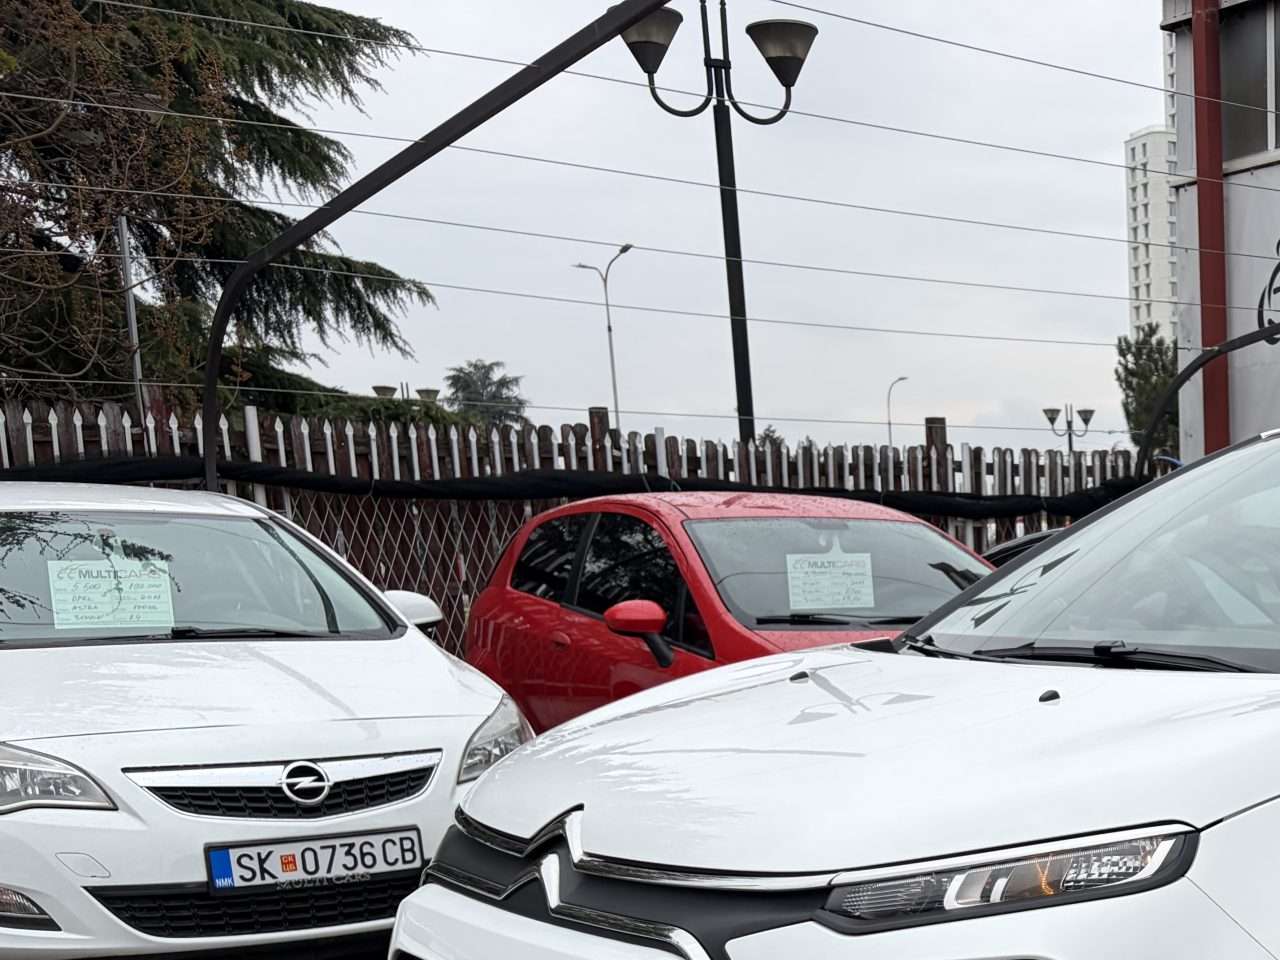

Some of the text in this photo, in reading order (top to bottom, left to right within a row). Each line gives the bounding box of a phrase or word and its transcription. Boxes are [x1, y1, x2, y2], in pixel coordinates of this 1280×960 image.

[236, 836, 417, 882] SK 0736 CB
[215, 877, 235, 888] NMK
